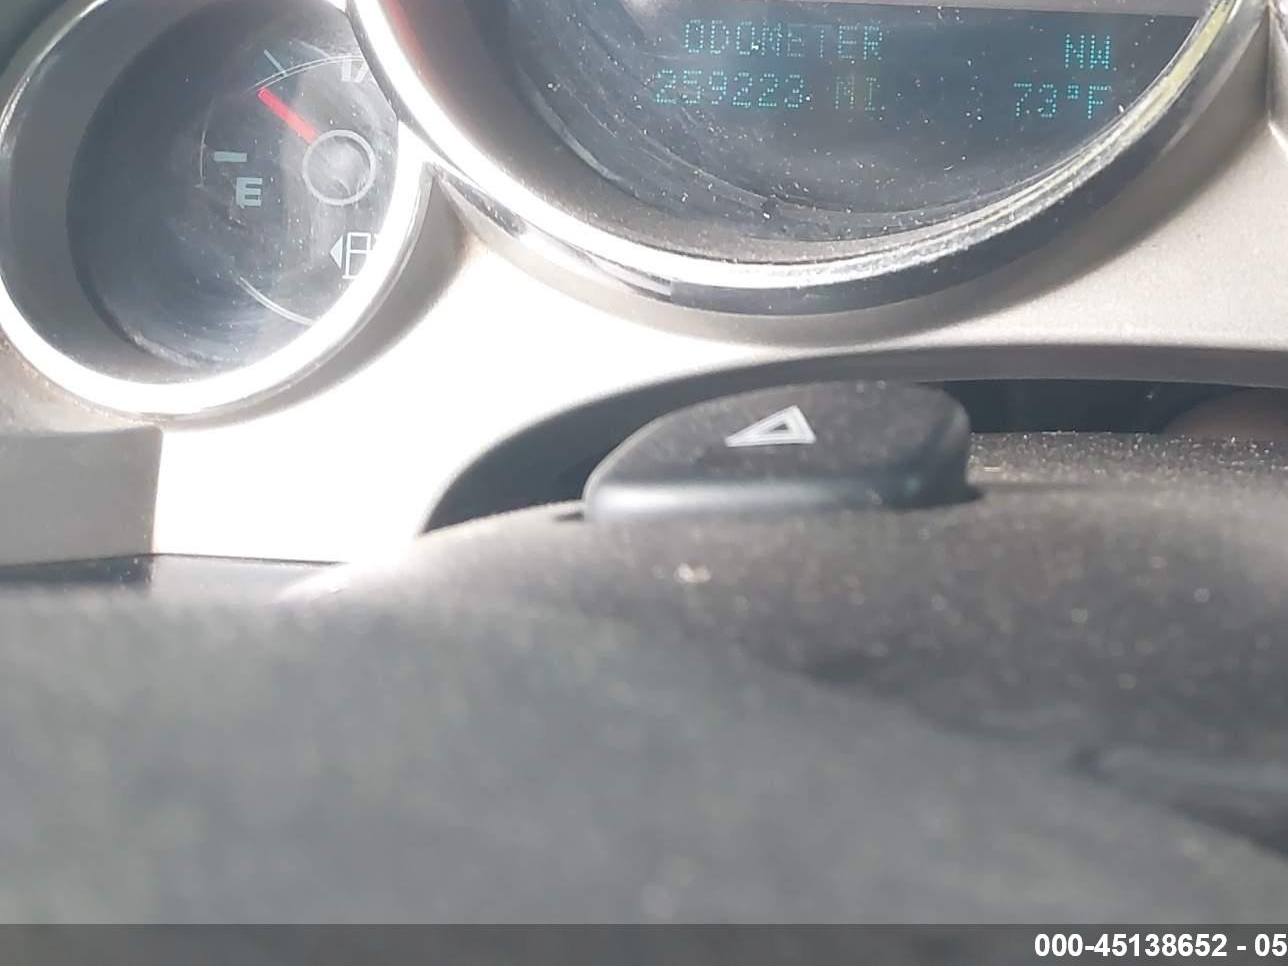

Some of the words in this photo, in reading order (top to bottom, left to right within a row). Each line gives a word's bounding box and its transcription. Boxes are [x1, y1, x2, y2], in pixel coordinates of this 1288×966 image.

[684, 18, 883, 61] ODOMETER
[1063, 34, 1112, 69] NW
[655, 69, 805, 108] 259223
[236, 177, 263, 207] E
